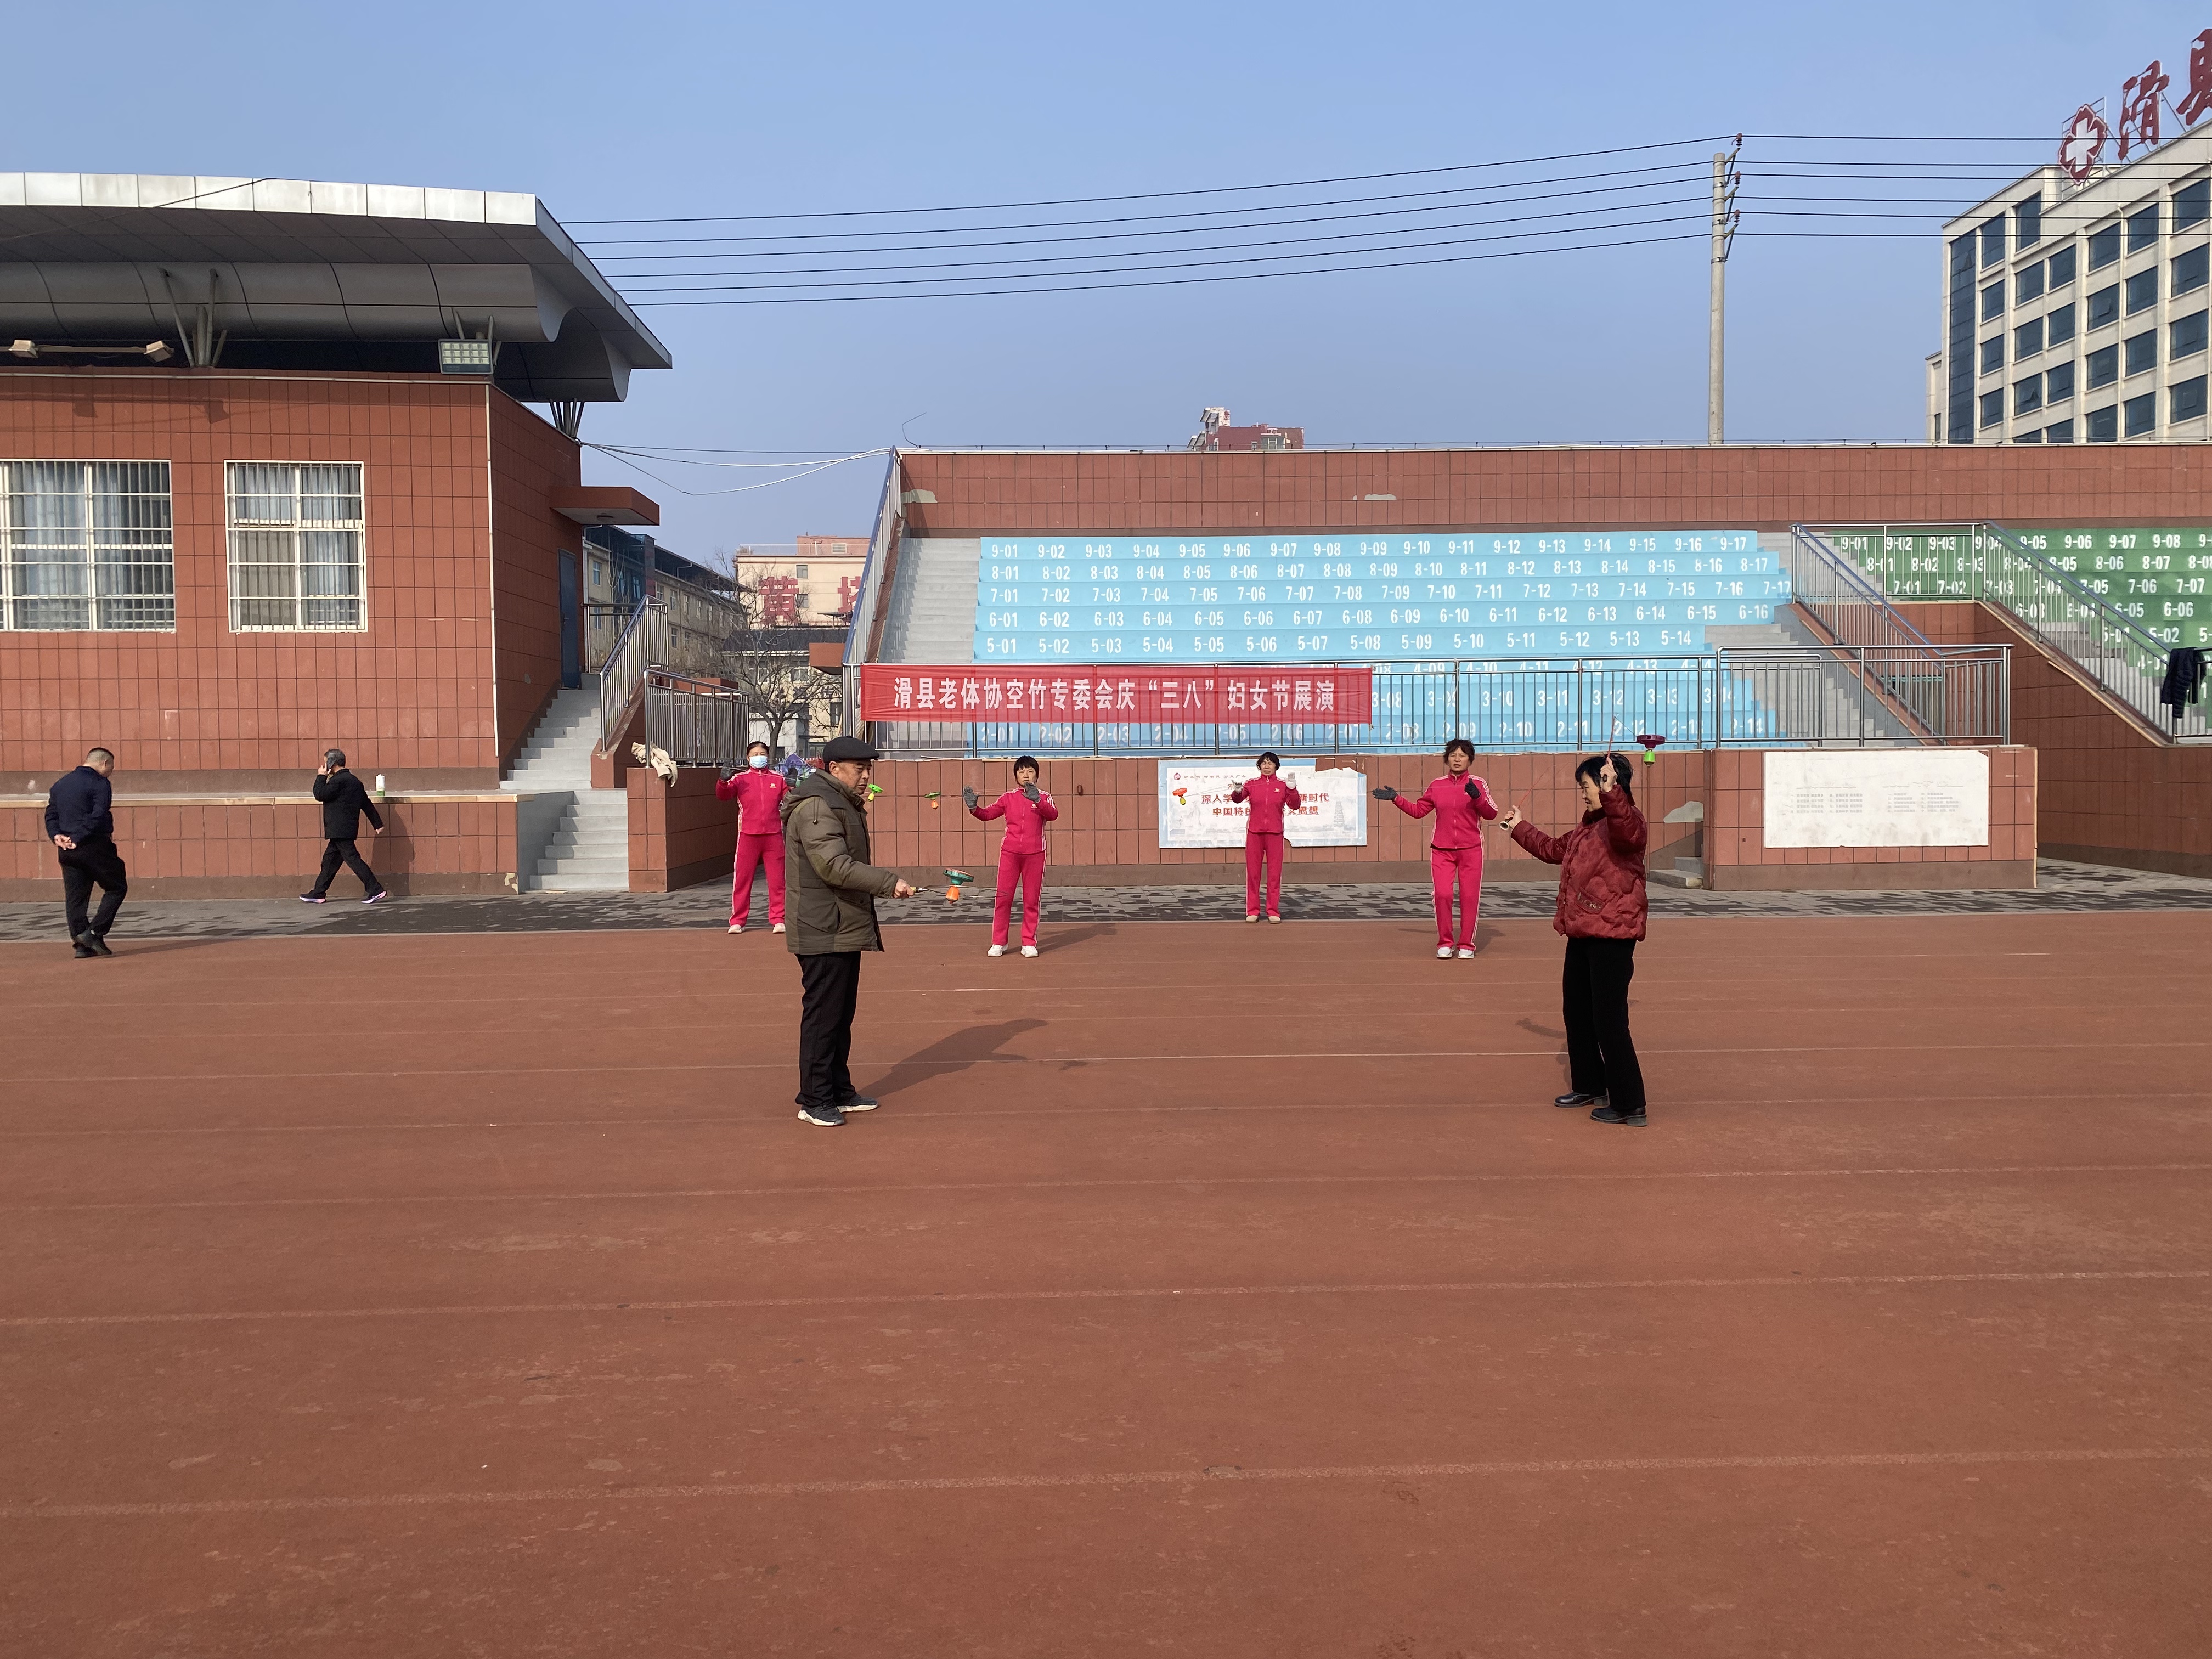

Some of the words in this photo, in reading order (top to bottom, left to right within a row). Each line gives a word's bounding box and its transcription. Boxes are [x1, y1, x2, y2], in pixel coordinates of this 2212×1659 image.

[991, 544, 1018, 558] 9-01
[1037, 544, 1065, 559] 9-02
[1085, 544, 1112, 558] 9-03
[1133, 544, 1160, 558] 9-04
[1179, 544, 1206, 558] 9-05
[1223, 543, 1251, 557] 9-06
[1271, 543, 1297, 557] 9-07
[1314, 542, 1341, 556] 9-08
[1360, 541, 1387, 556] 9-09
[1404, 540, 1430, 555] 9-10
[1448, 540, 1474, 554] 9-11
[1494, 539, 1521, 554] 9-12
[1538, 539, 1566, 554] 9-13
[1584, 538, 1611, 552] 9-14
[1629, 538, 1656, 551] 9-15
[1675, 537, 1702, 552] 9-16
[1720, 536, 1747, 551] 9-17
[1842, 537, 1867, 550] 9-01
[1886, 536, 1911, 550] 9-02
[1929, 536, 1955, 550] 9-03
[2020, 535, 2047, 550] 9-05
[2064, 534, 2092, 549] 9-06
[2108, 534, 2137, 549] 9-07
[2152, 534, 2181, 548] 9-08
[991, 566, 1019, 580] 8-01
[1042, 566, 1070, 580] 8-02
[1091, 565, 1118, 580] 8-03
[1137, 565, 1165, 580] 8-04
[1183, 565, 1211, 579] 8-05
[1230, 565, 1258, 579] 8-06
[1277, 563, 1305, 578] 8-07
[1323, 563, 1352, 578] 8-08
[1370, 563, 1398, 577] 8-09
[1415, 562, 1443, 576] 8-10
[1460, 561, 1486, 576] 8-11
[1508, 561, 1535, 575] 8-12
[1554, 560, 1581, 574] 8-13
[1601, 559, 1629, 574] 8-14
[1648, 559, 1675, 573] 8-15
[1695, 558, 1723, 573] 8-16
[1741, 557, 1768, 572] 8-17
[1912, 557, 1938, 572] 8-02
[2050, 556, 2078, 571] 8-05
[2096, 556, 2124, 571] 8-06
[2142, 555, 2171, 570] 8-07
[990, 588, 1018, 603] 7-01
[1041, 588, 1070, 603] 7-02
[1092, 588, 1121, 602] 7-03
[1141, 587, 1169, 602] 7-04
[1189, 587, 1218, 602] 7-05
[1237, 586, 1266, 601] 7-06
[1285, 586, 1314, 601] 7-07
[1334, 585, 1362, 600] 7-08
[1382, 585, 1410, 600] 7-09
[1427, 584, 1455, 599] 7-10
[1475, 584, 1502, 599] 7-11
[1523, 583, 1551, 598] 7-12
[1571, 582, 1599, 597] 7-13
[1619, 582, 1647, 597] 7-14
[1667, 582, 1695, 596] 7-15
[1716, 581, 1743, 596] 7-16
[1763, 580, 1791, 595] 7-17
[1894, 580, 1921, 594] 7-01
[1938, 580, 1967, 595] 7-02
[2080, 579, 2109, 594] 7-05
[2128, 579, 2157, 594] 7-06
[2176, 578, 2205, 593] 7-07
[989, 612, 1018, 628] 6-01
[1040, 611, 1069, 628] 6-02
[1094, 611, 1124, 627] 6-03
[1143, 611, 1172, 627] 6-04
[1195, 611, 1224, 626] 6-05
[1244, 610, 1273, 626] 6-06
[1293, 610, 1322, 625] 6-07
[1342, 609, 1372, 624] 6-08
[1390, 608, 1420, 624] 6-09
[1440, 608, 1469, 623] 6-10
[1489, 607, 1517, 622] 6-11
[1538, 607, 1567, 622] 6-12
[1588, 606, 1617, 622] 6-13
[1636, 605, 1666, 620] 6-14
[1687, 605, 1717, 620] 6-15
[1739, 604, 1768, 619] 6-16
[2163, 601, 2194, 617] 6-06
[986, 637, 1016, 654] 5-01
[1039, 638, 1069, 654] 5-02
[1091, 637, 1122, 653] 5-03
[1143, 637, 1173, 653] 5-04
[1194, 636, 1224, 652] 5-05
[1246, 636, 1277, 652] 5-06
[1297, 635, 1328, 651] 5-07
[1351, 635, 1381, 650] 5-08
[1401, 634, 1432, 650] 5-09
[1454, 633, 1484, 648] 5-10
[1507, 632, 1535, 648] 5-11
[1560, 631, 1590, 647] 5-12
[1610, 630, 1639, 646] 5-13
[1661, 630, 1691, 645] 5-14
[2149, 627, 2180, 643] 5-02
[1466, 661, 1498, 676] 4-10
[1519, 661, 1548, 676] 4-11
[1372, 691, 1402, 708] 3-08
[1482, 690, 1513, 707] 3-10
[1537, 689, 1568, 707] 3-11
[1593, 689, 1623, 706] 3-12
[1647, 688, 1677, 705] 3-13
[981, 727, 1013, 744] 2-01
[1040, 726, 1073, 744] 2-02
[1097, 726, 1129, 743] 2-03
[1155, 725, 1188, 742] 2-04
[1272, 724, 1303, 741] 2-06
[1386, 723, 1419, 740] 2-08
[1442, 722, 1476, 739] 2-09
[1499, 721, 1533, 738] 2-10
[1558, 721, 1588, 737] 2-11
